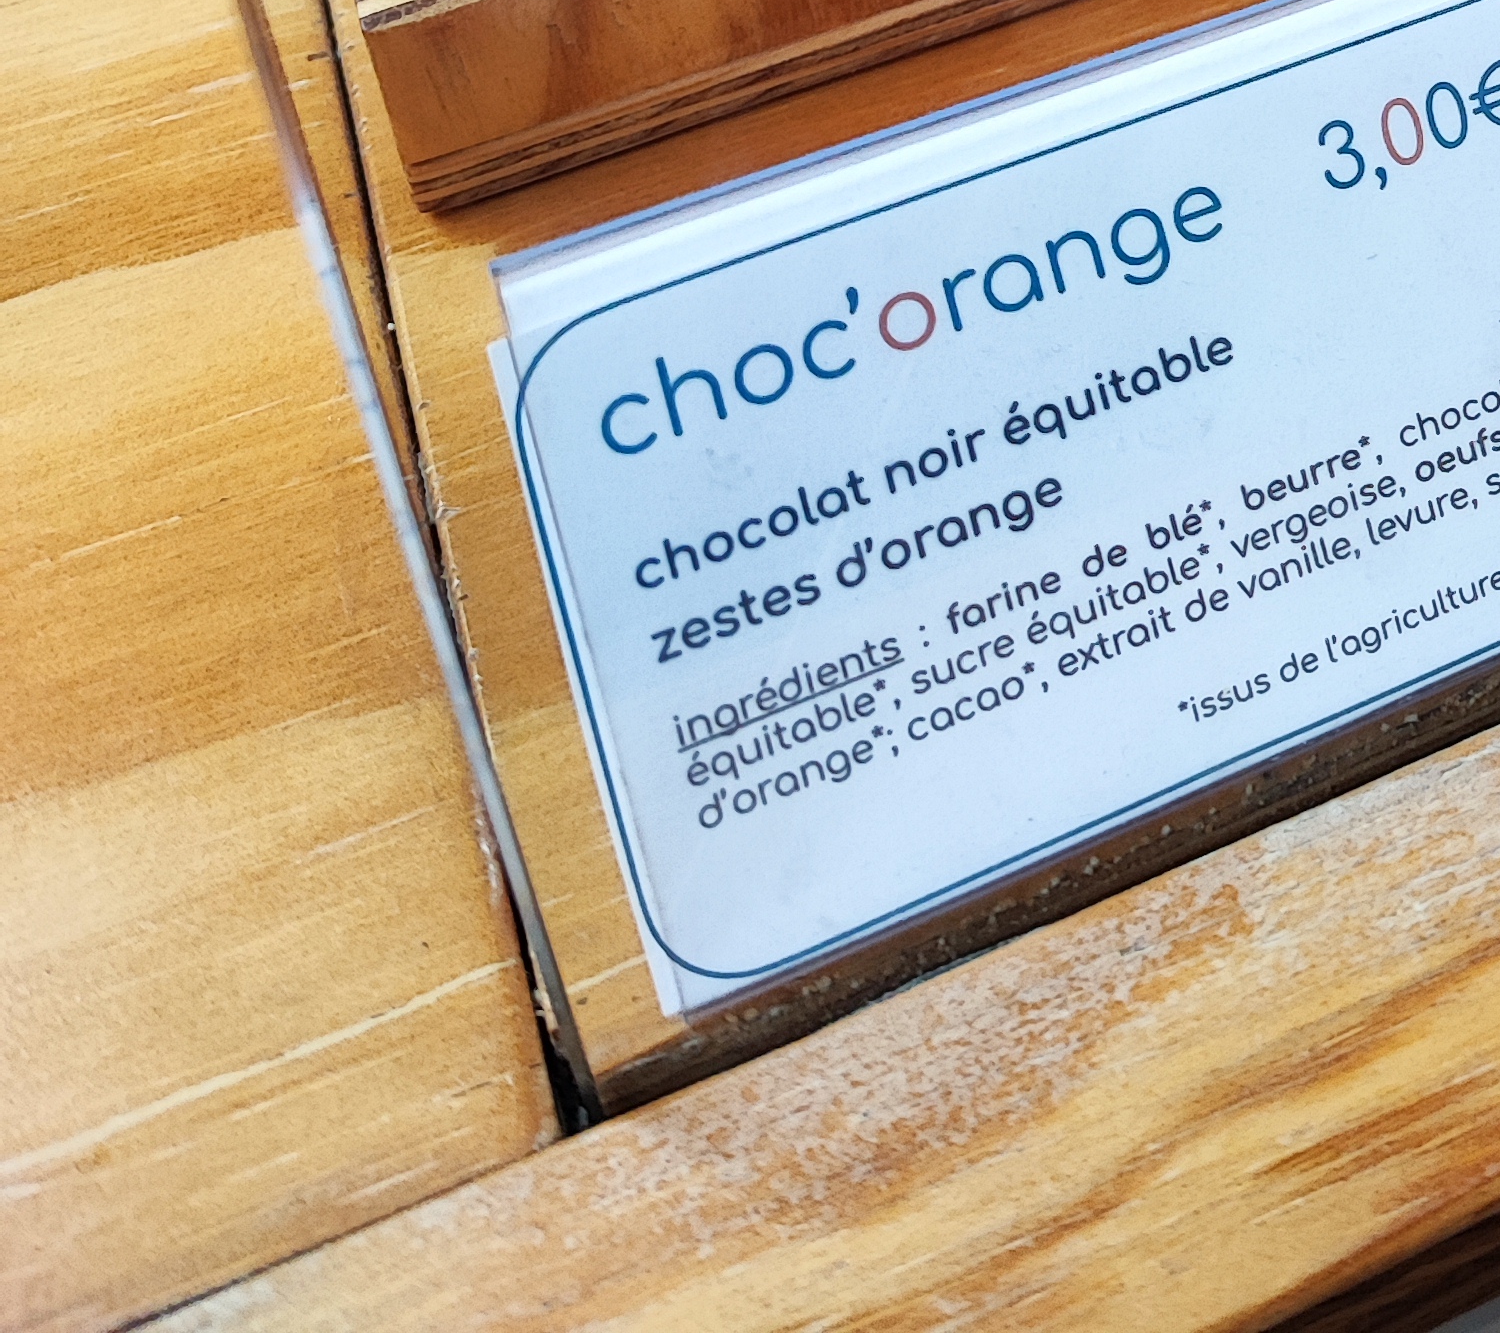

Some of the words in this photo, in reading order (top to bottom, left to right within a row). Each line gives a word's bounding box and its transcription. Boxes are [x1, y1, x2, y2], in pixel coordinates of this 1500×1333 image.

[601, 186, 1221, 453] choc'orange
[636, 470, 870, 588] chocolat
[885, 429, 985, 494] noir
[1003, 336, 1233, 445] équitable
[651, 573, 820, 663] zestes
[836, 477, 1062, 587] d'orange
[673, 634, 904, 753] ingrédients
[947, 569, 1061, 634] farine
[1083, 545, 1127, 577] de
[912, 630, 1014, 694] sucre
[1231, 474, 1406, 557] vergeoise,
[1057, 607, 1174, 676] extrait
[1185, 587, 1230, 623] de
[1238, 533, 1360, 599] vanille,
[1367, 484, 1478, 547] levure,
[1280, 645, 1319, 684] de
